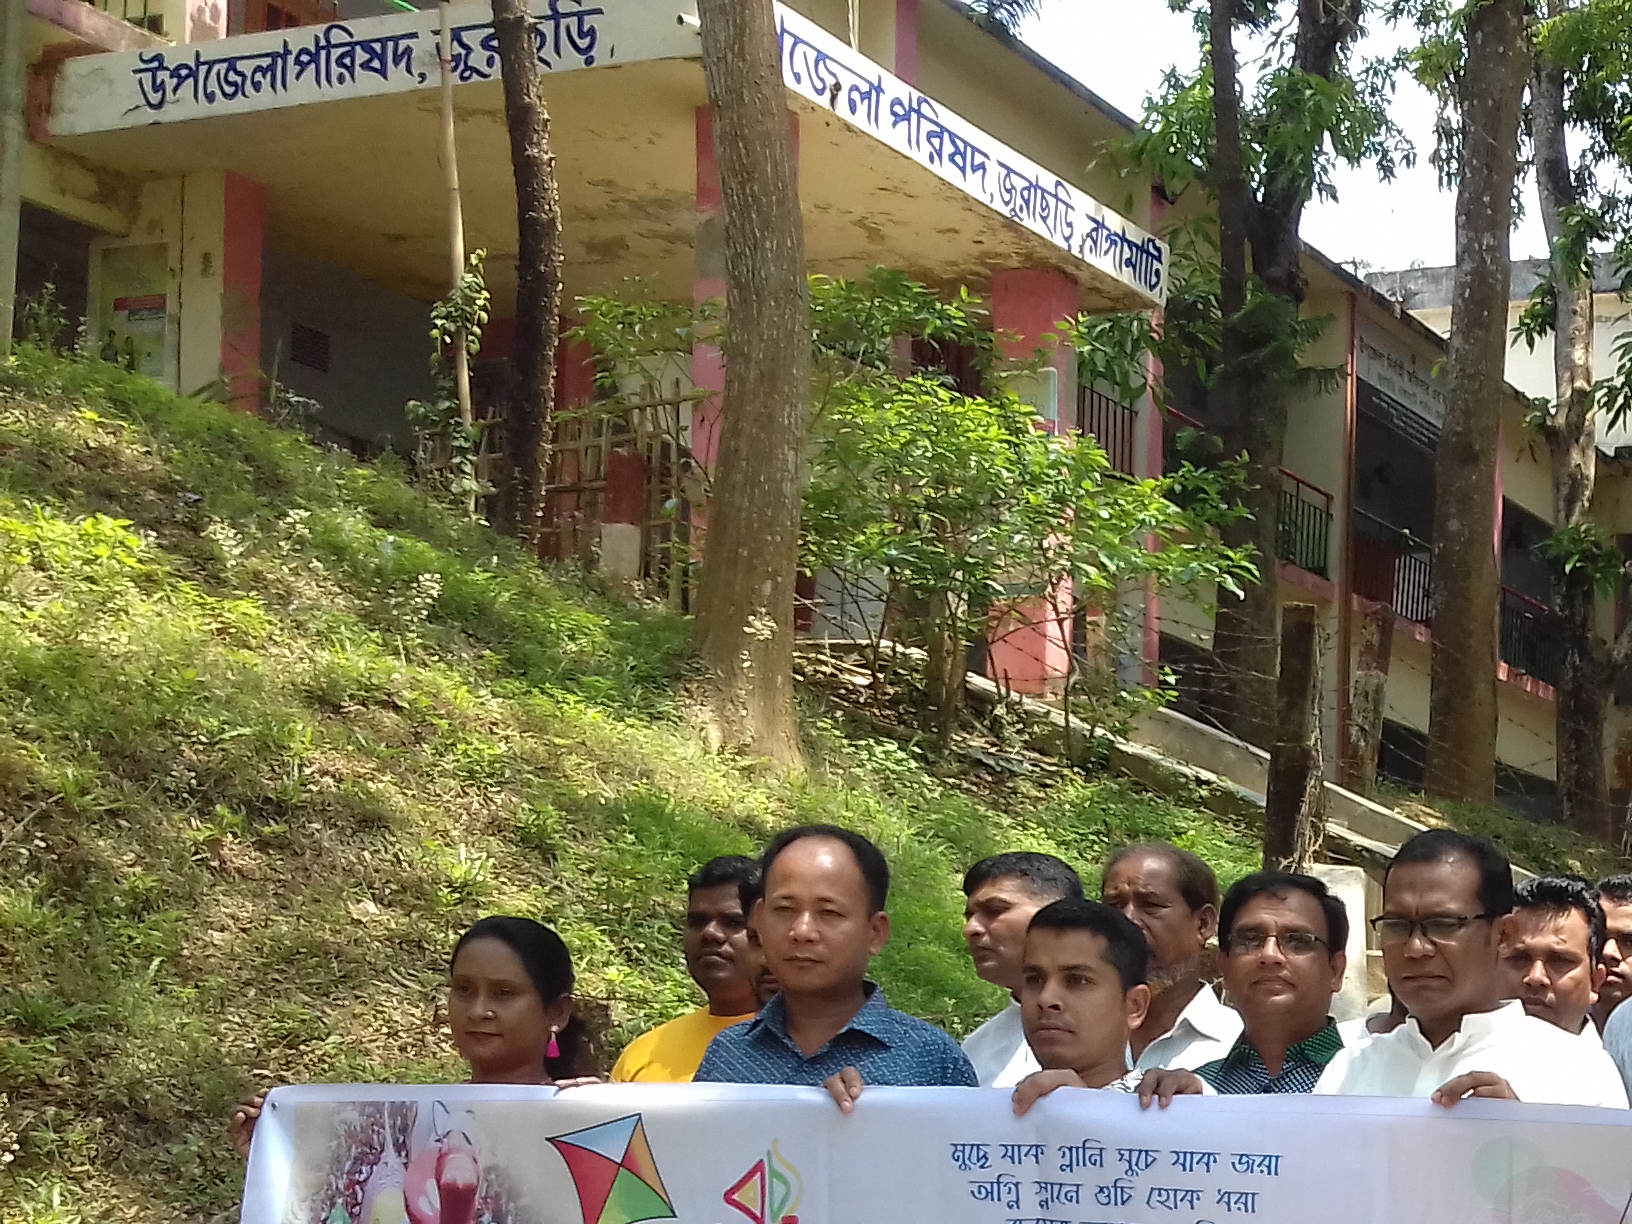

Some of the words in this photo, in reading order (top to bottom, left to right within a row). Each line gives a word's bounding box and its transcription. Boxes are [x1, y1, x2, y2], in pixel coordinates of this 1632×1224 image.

[950, 1142, 991, 1171] মুছে
[999, 1143, 1046, 1165] যাক
[1057, 1138, 1107, 1173] গ্লানি
[1115, 1148, 1162, 1177] ঘুচে
[1170, 1149, 1221, 1173] যাক
[1230, 1152, 1283, 1177] জরা
[969, 1174, 1023, 1209] অগ্নি
[1033, 1179, 1083, 1210] স্নানে
[1094, 1177, 1136, 1208] শুচি
[1146, 1185, 1204, 1212] হোক
[1215, 1188, 1260, 1214] ধরা
